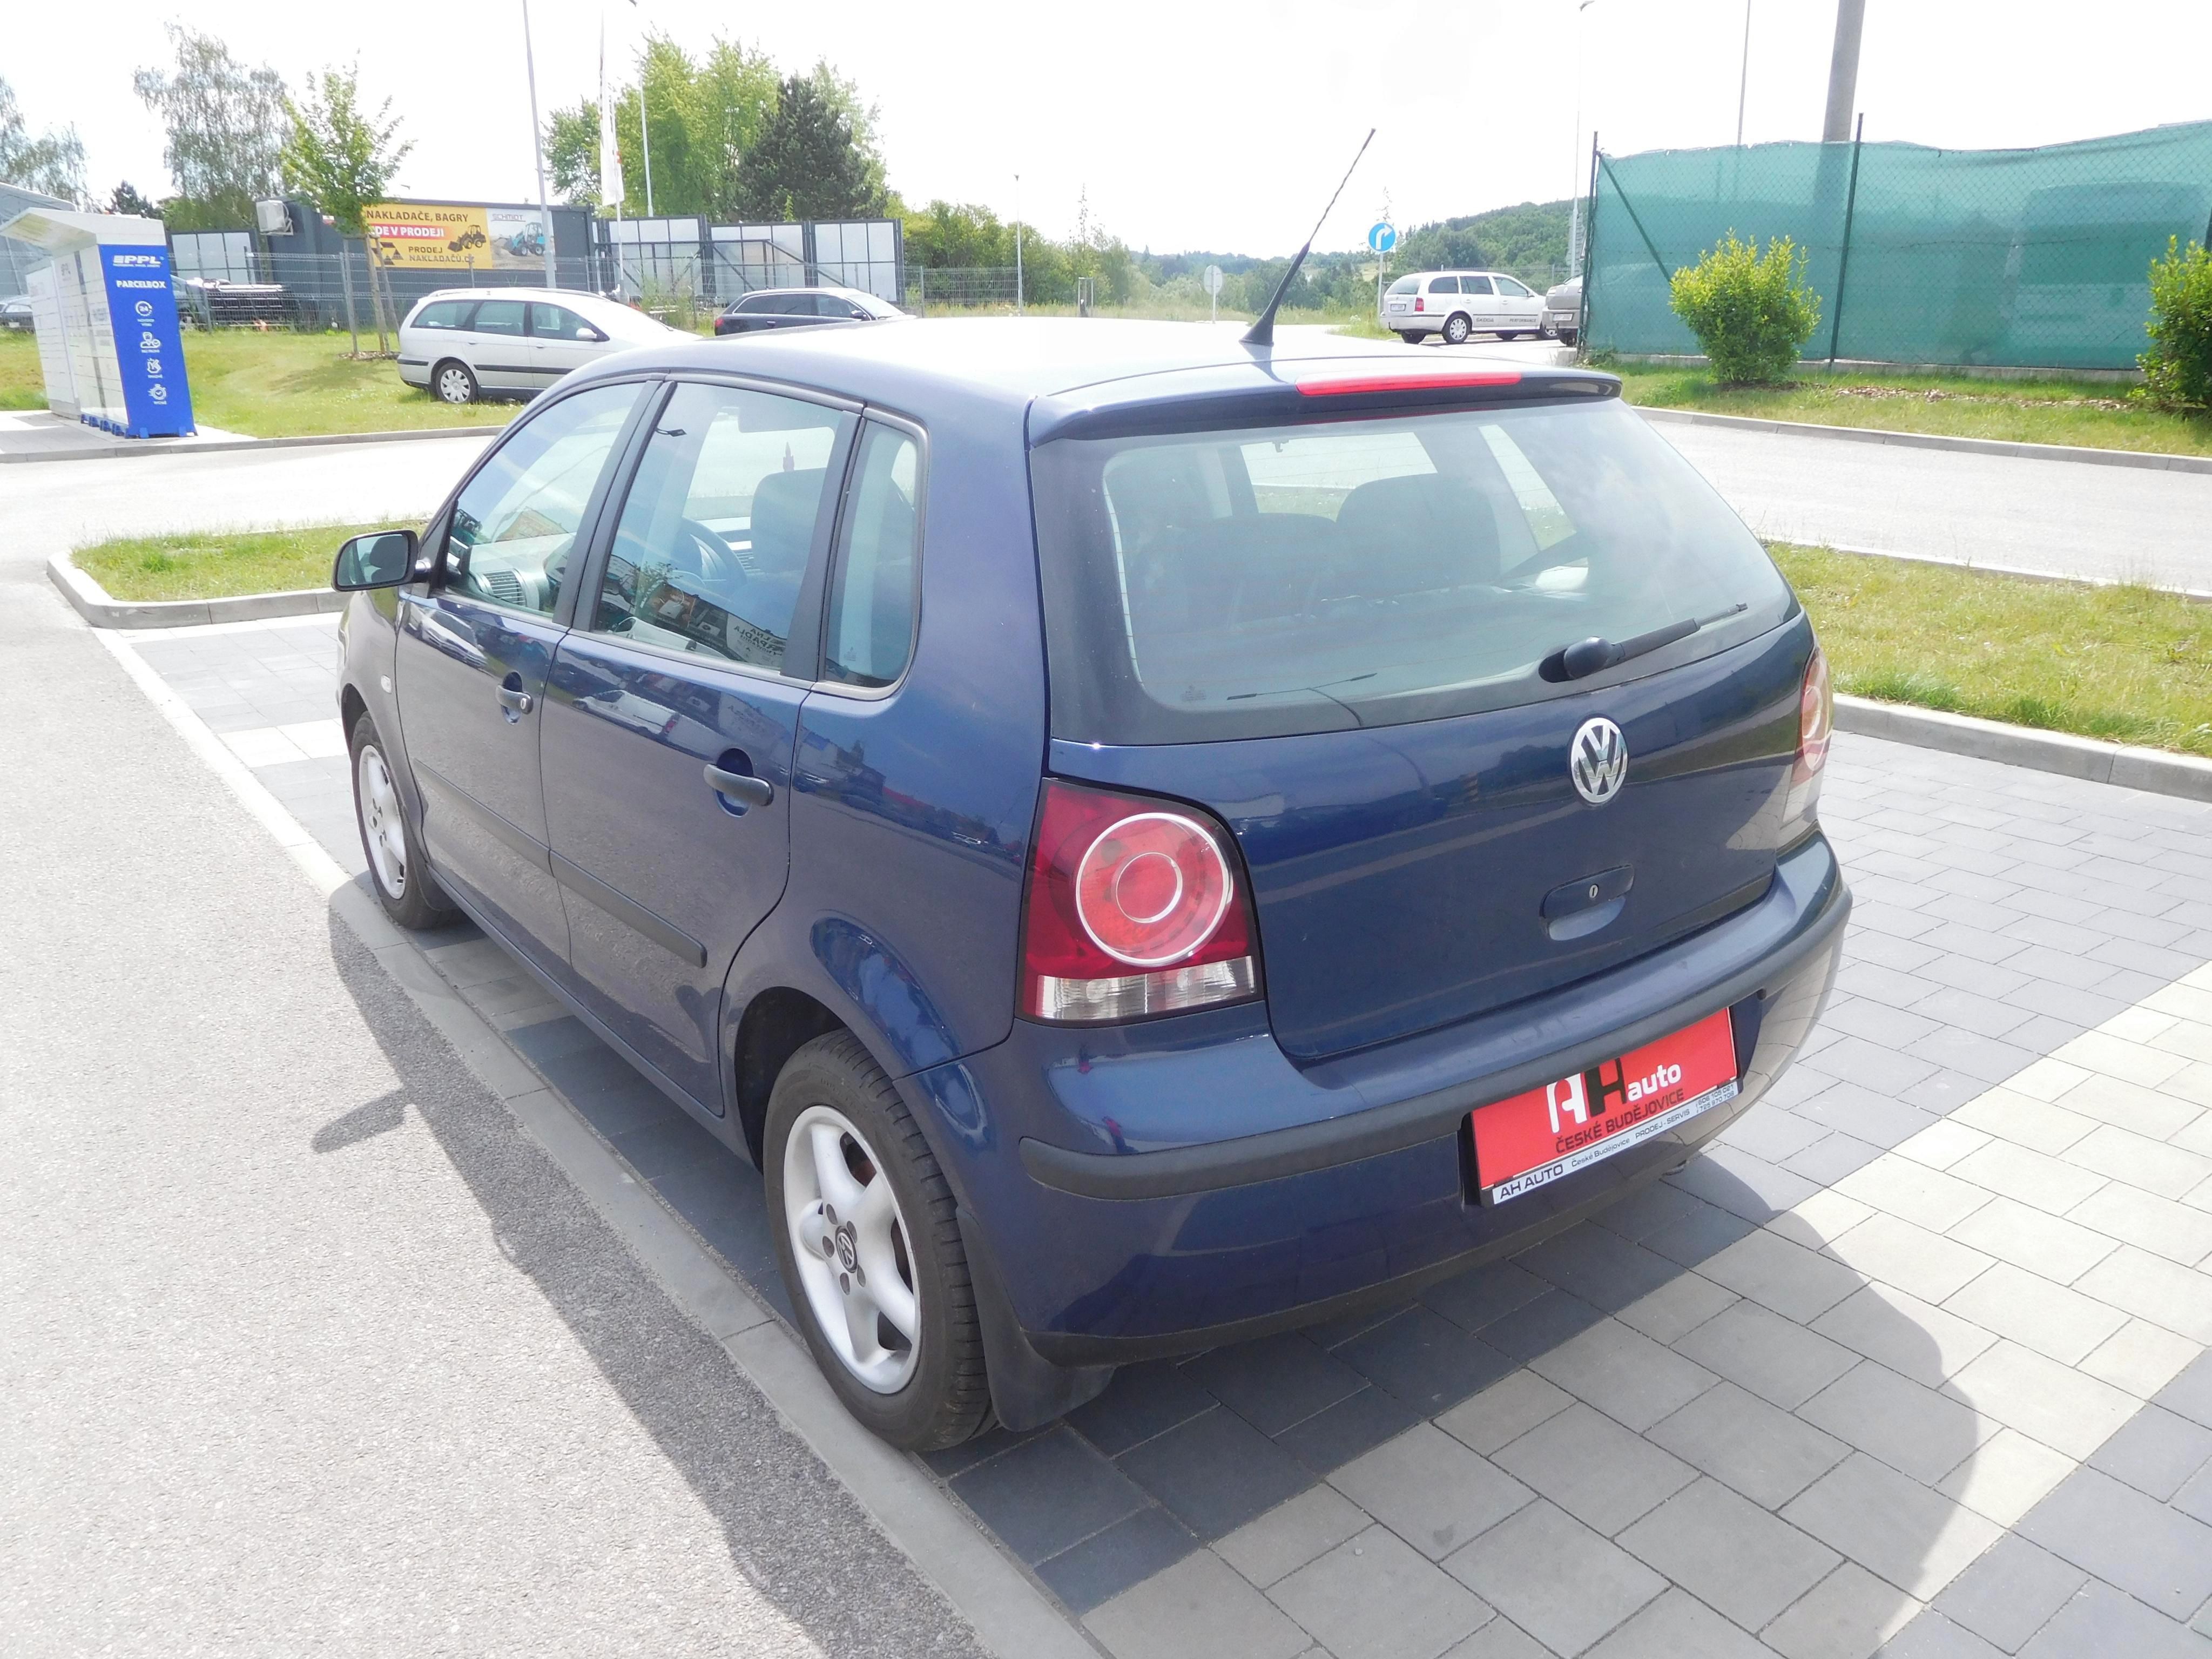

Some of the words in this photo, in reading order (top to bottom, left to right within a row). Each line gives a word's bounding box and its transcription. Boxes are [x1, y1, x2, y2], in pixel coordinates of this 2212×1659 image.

[367, 210, 433, 222] NAKLADAČE,
[435, 213, 469, 222] BAGRY
[390, 226, 398, 235] V
[400, 226, 444, 237] PRODEJI
[408, 246, 443, 254] PRODEJ
[116, 280, 166, 288] PARCELBOX
[1628, 1063, 1682, 1102] auto
[1555, 1121, 1603, 1154] ČESKÉ
[1606, 1088, 1684, 1133] BUDĚJOVICE
[1500, 1181, 1521, 1199] AH
[1525, 1163, 1563, 1189] AUTO
[1572, 1154, 1594, 1167] České
[1594, 1138, 1630, 1158] Budějovice
[1635, 1123, 1663, 1139] PRODEJ
[1667, 1109, 1690, 1124] SERVIS
